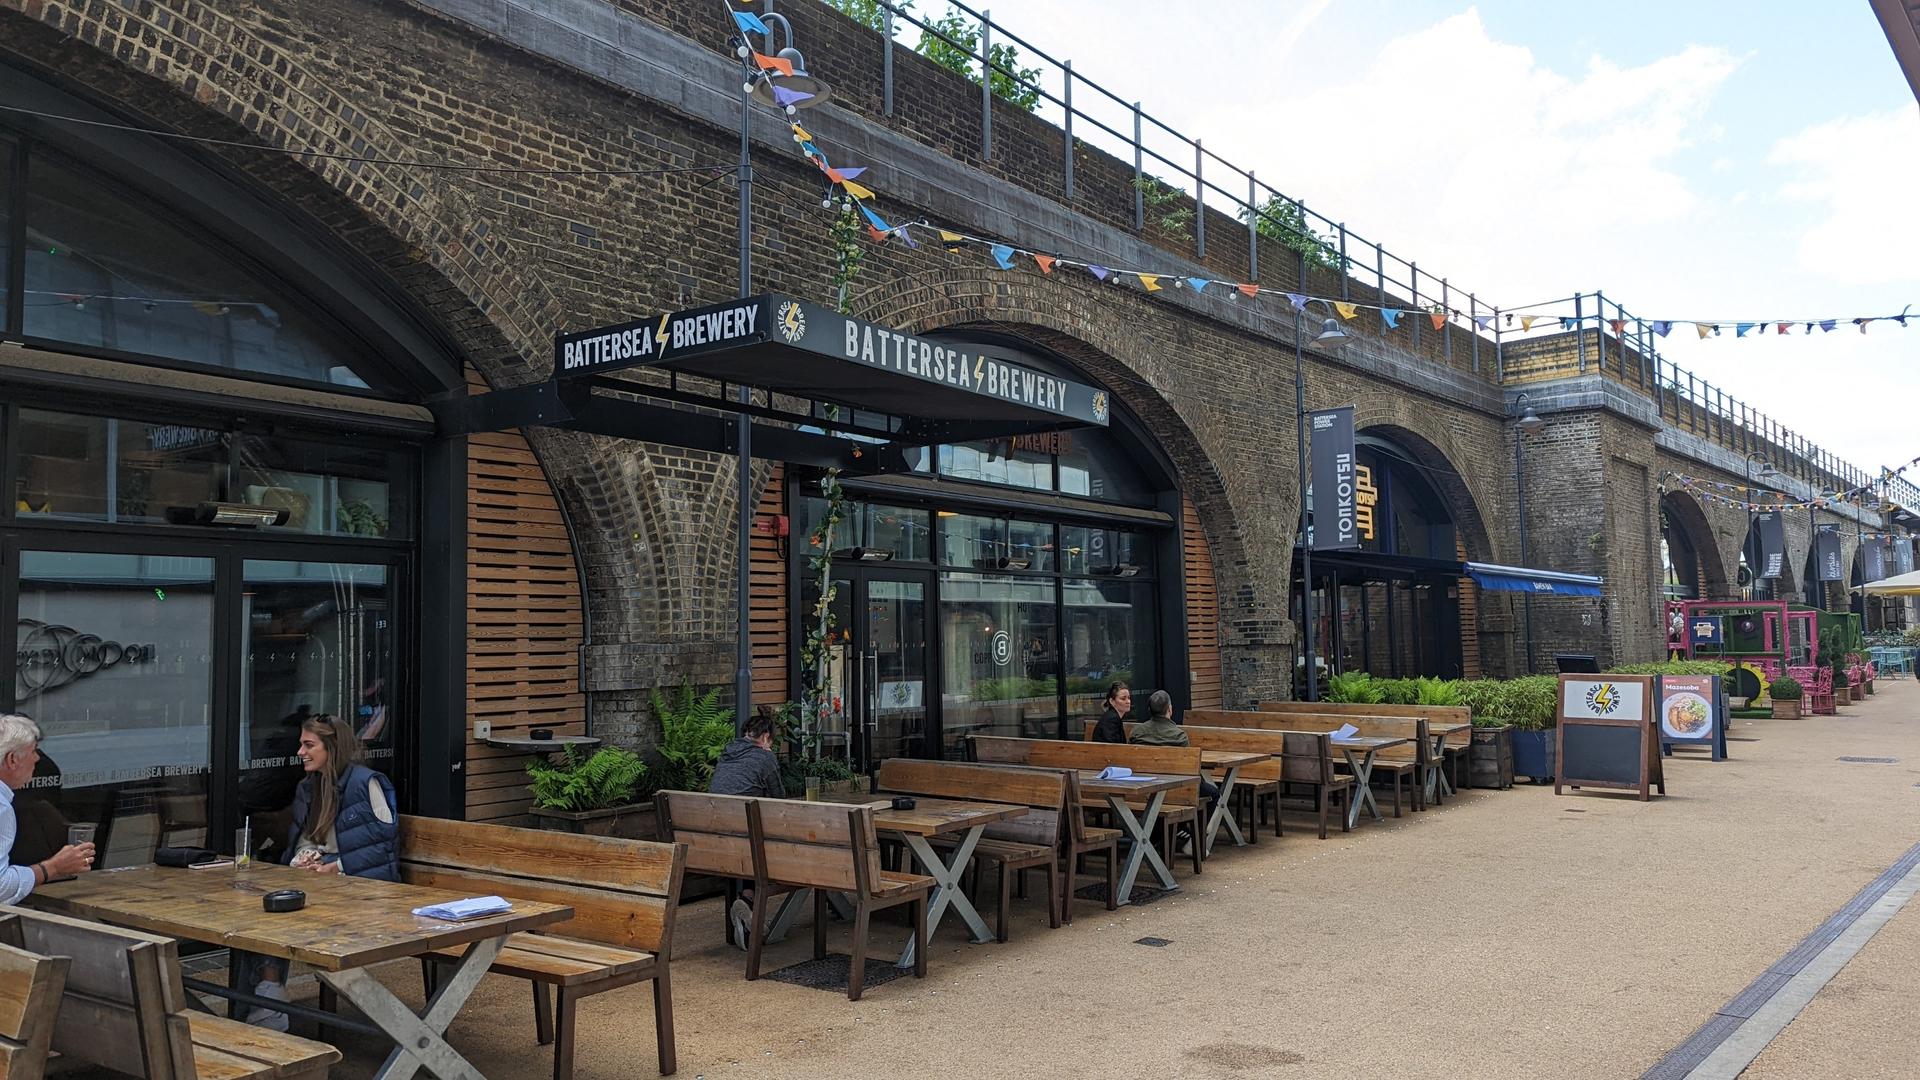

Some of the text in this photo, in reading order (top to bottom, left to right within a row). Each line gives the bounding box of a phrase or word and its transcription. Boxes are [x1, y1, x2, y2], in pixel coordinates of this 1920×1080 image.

[564, 304, 759, 370] BATTERSEA BREWERY
[778, 301, 806, 342] BATTERSEA BREWERY
[845, 320, 971, 388] BATTERSEA
[988, 361, 1067, 412] BREWERY
[1336, 453, 1353, 542] TONKOTSU
[1586, 684, 1621, 714] BATTERSEA BREWERY
[251, 756, 286, 769] BREWERY
[364, 748, 394, 760] BATTERS
[17, 774, 64, 790] ATTERSEA
[164, 762, 204, 776] BREWERY
